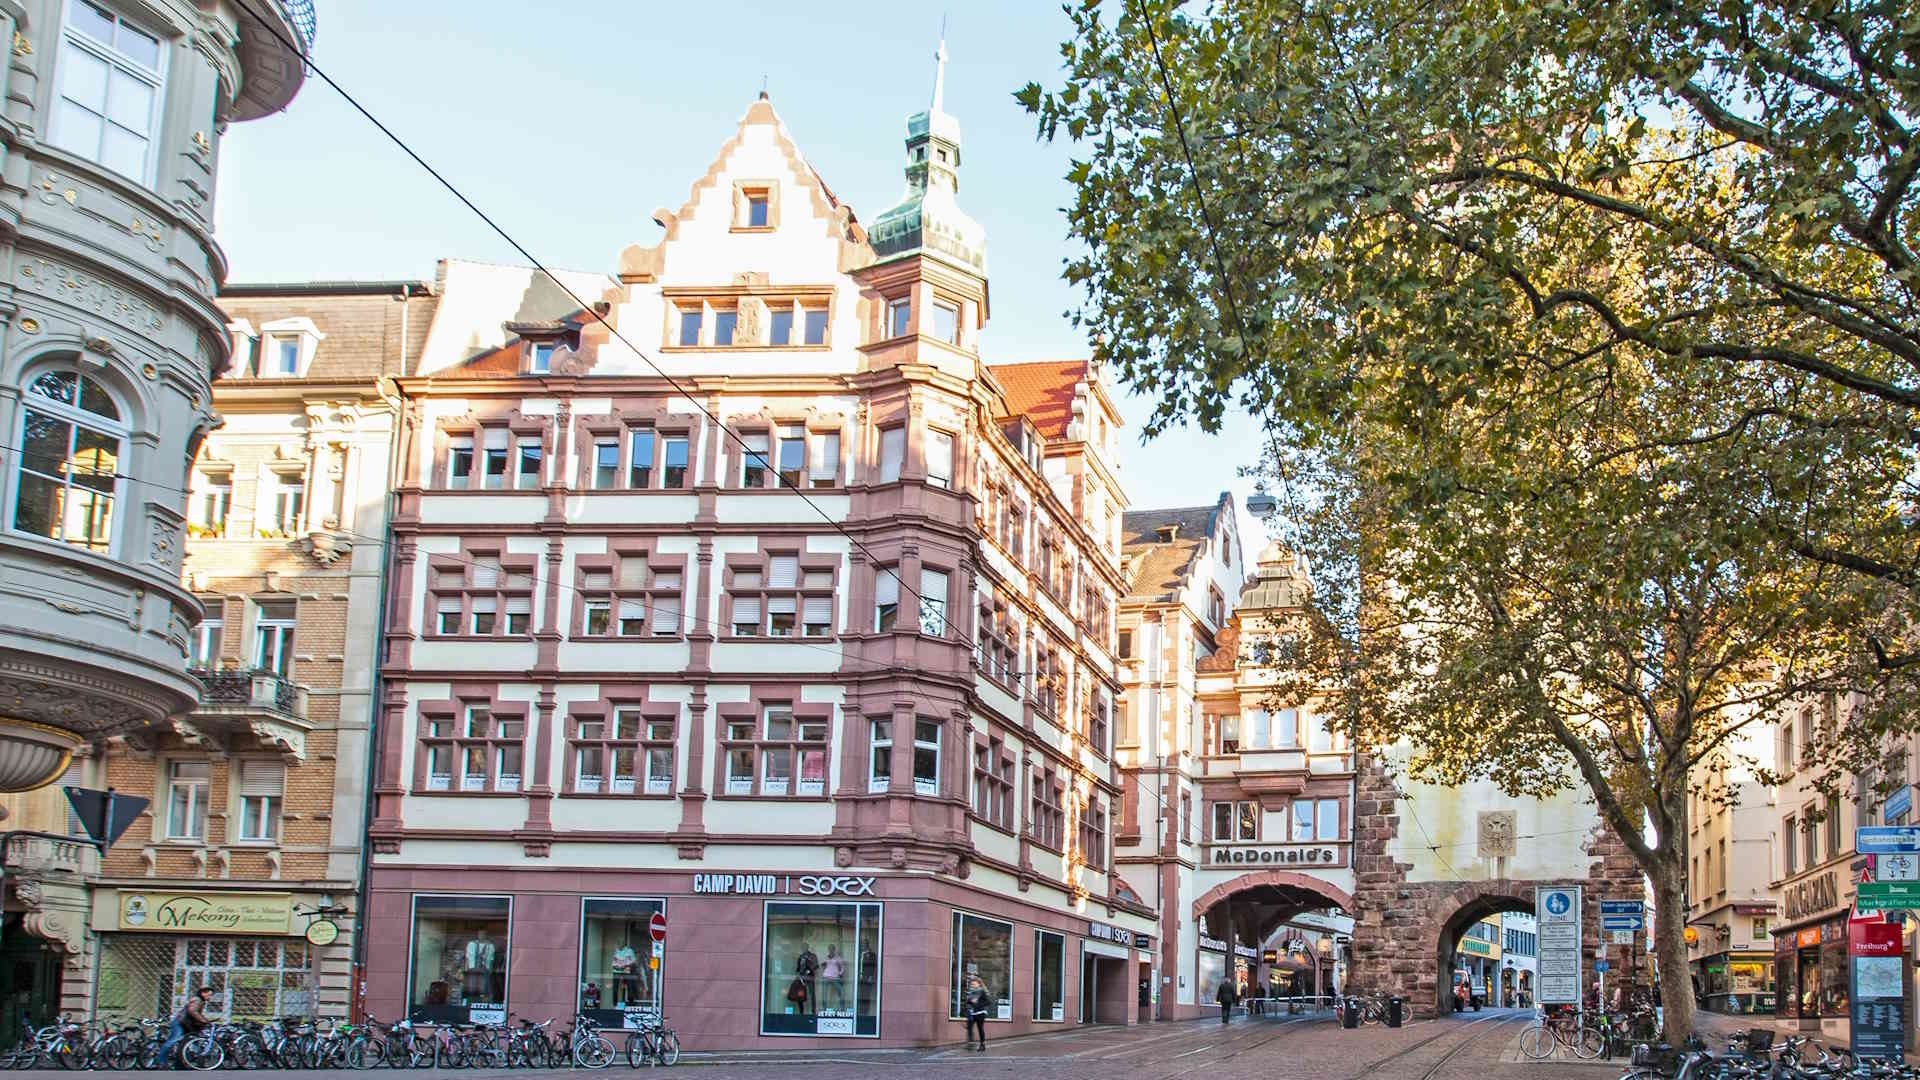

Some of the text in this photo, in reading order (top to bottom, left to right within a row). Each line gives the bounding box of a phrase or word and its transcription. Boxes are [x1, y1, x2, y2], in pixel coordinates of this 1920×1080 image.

[1215, 848, 1333, 863] McDonald's
[694, 874, 733, 893] CAMP
[735, 875, 776, 894] DAVID
[1784, 871, 1838, 920] MAGAZIN
[164, 905, 241, 927] Mekong
